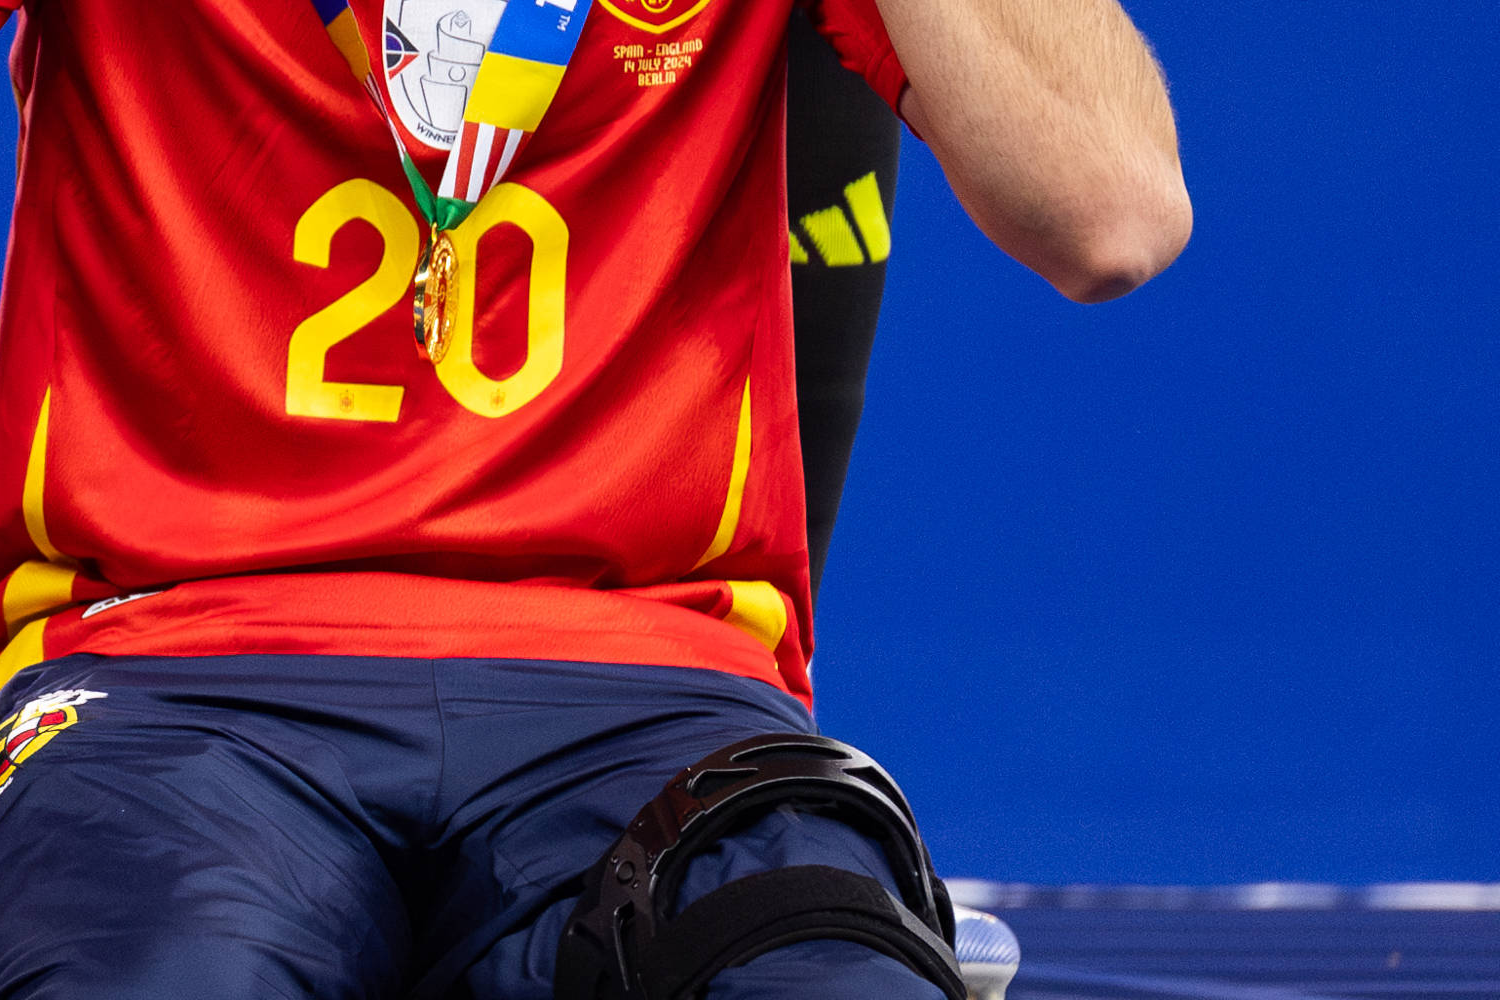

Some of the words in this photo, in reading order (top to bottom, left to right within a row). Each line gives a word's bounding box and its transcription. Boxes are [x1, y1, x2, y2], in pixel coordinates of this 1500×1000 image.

[613, 44, 644, 59] SPAIN
[655, 38, 703, 57] ENGLAND
[624, 59, 635, 73] 14
[638, 57, 661, 72] JULY
[663, 55, 692, 71] 2024
[638, 71, 676, 87] BERLIN
[416, 121, 457, 145] WINNE
[285, 177, 570, 423] 20
